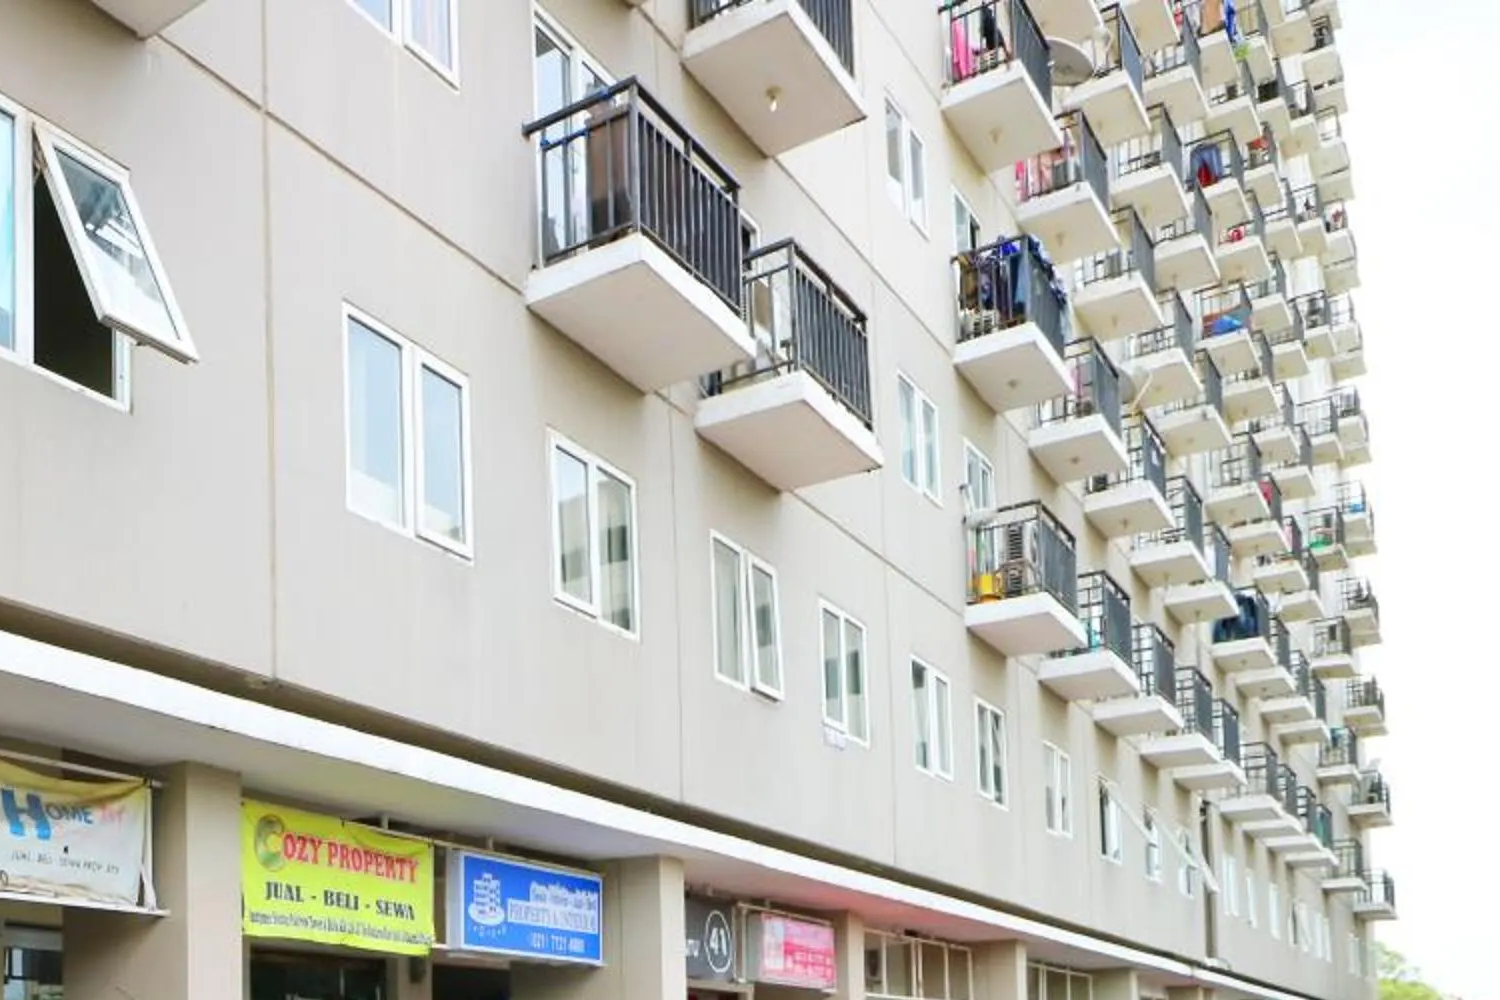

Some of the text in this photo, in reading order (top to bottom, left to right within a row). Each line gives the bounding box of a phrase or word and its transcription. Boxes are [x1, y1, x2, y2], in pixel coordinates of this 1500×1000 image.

[0, 788, 94, 841] HOME
[326, 840, 420, 884] PROPERTY
[265, 881, 304, 903] JUAL
[323, 889, 359, 910] BELI
[375, 898, 416, 920] SEWA
[709, 927, 728, 957] 41
